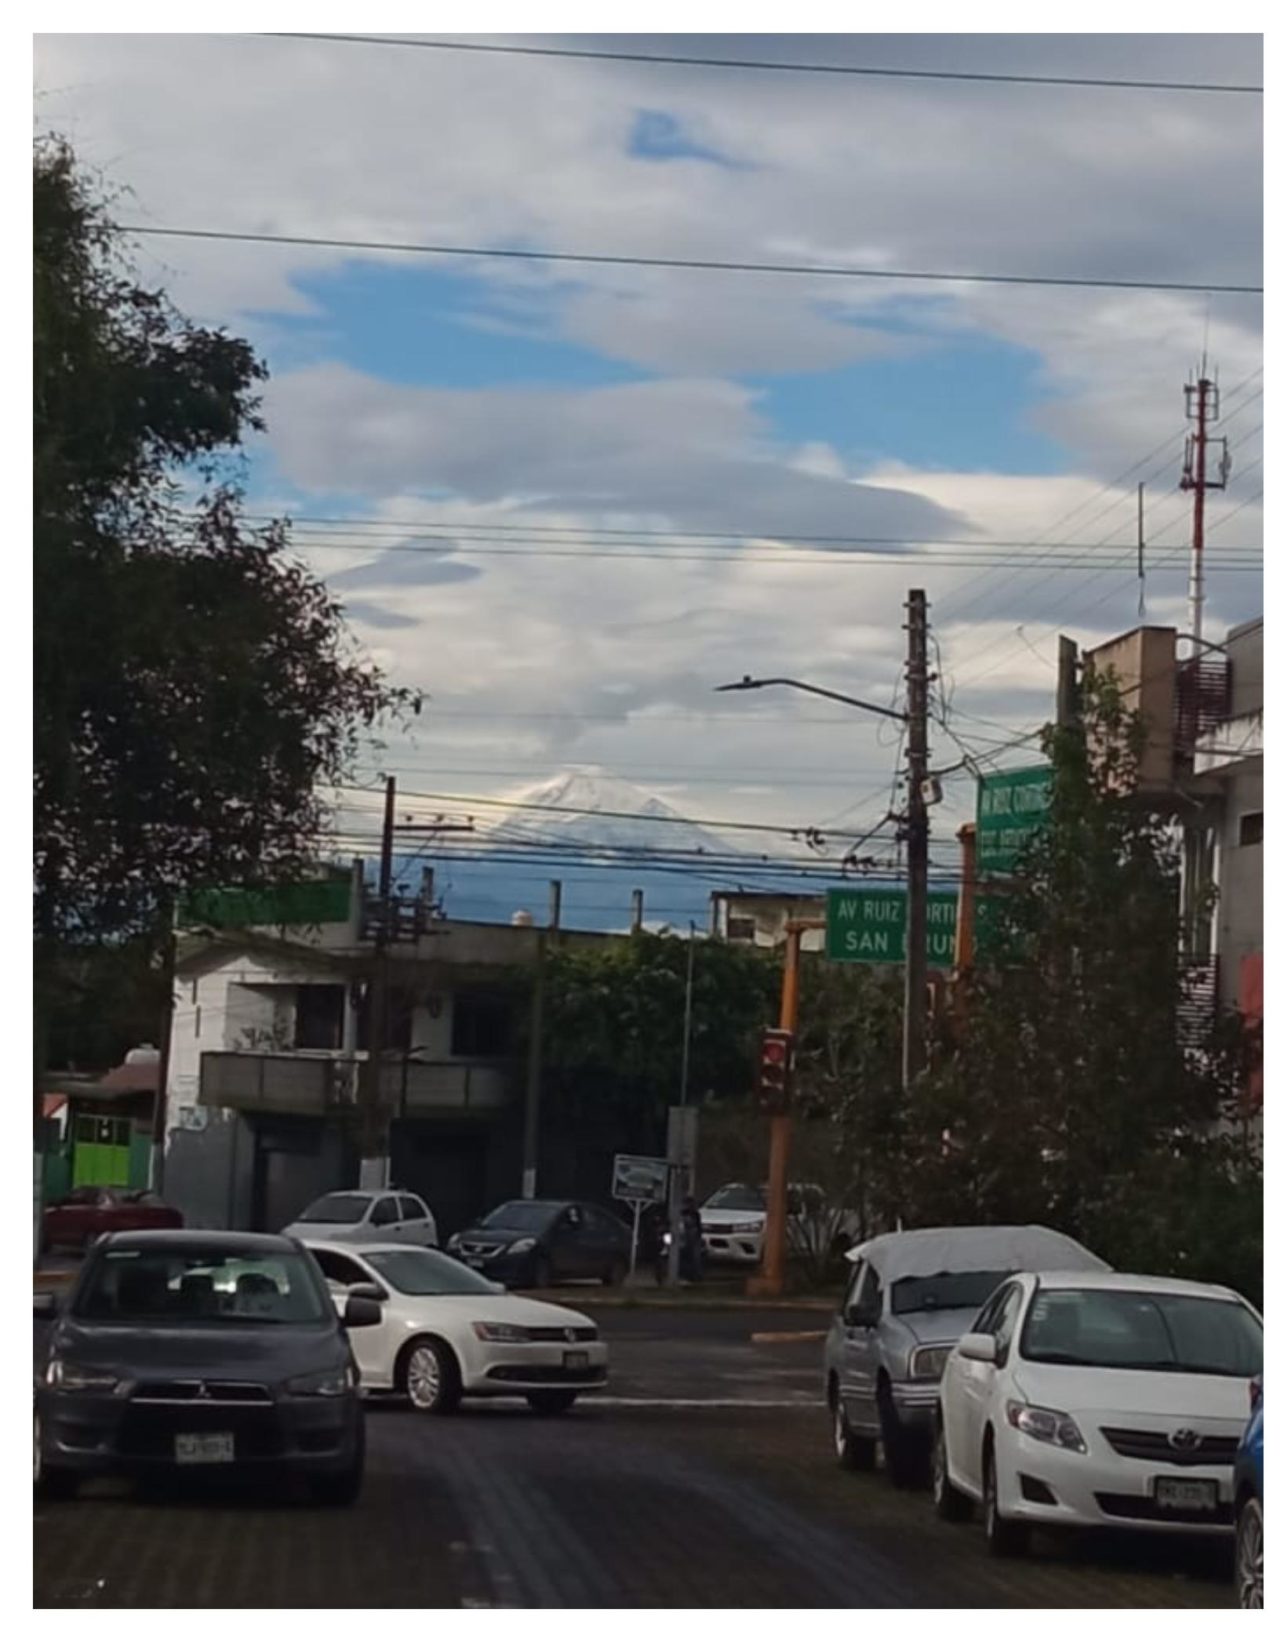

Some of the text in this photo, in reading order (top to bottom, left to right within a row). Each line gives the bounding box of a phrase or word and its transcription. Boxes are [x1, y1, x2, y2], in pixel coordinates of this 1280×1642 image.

[837, 900, 857, 921] AV
[863, 900, 902, 922] RUIZ
[845, 931, 889, 953] SAN
